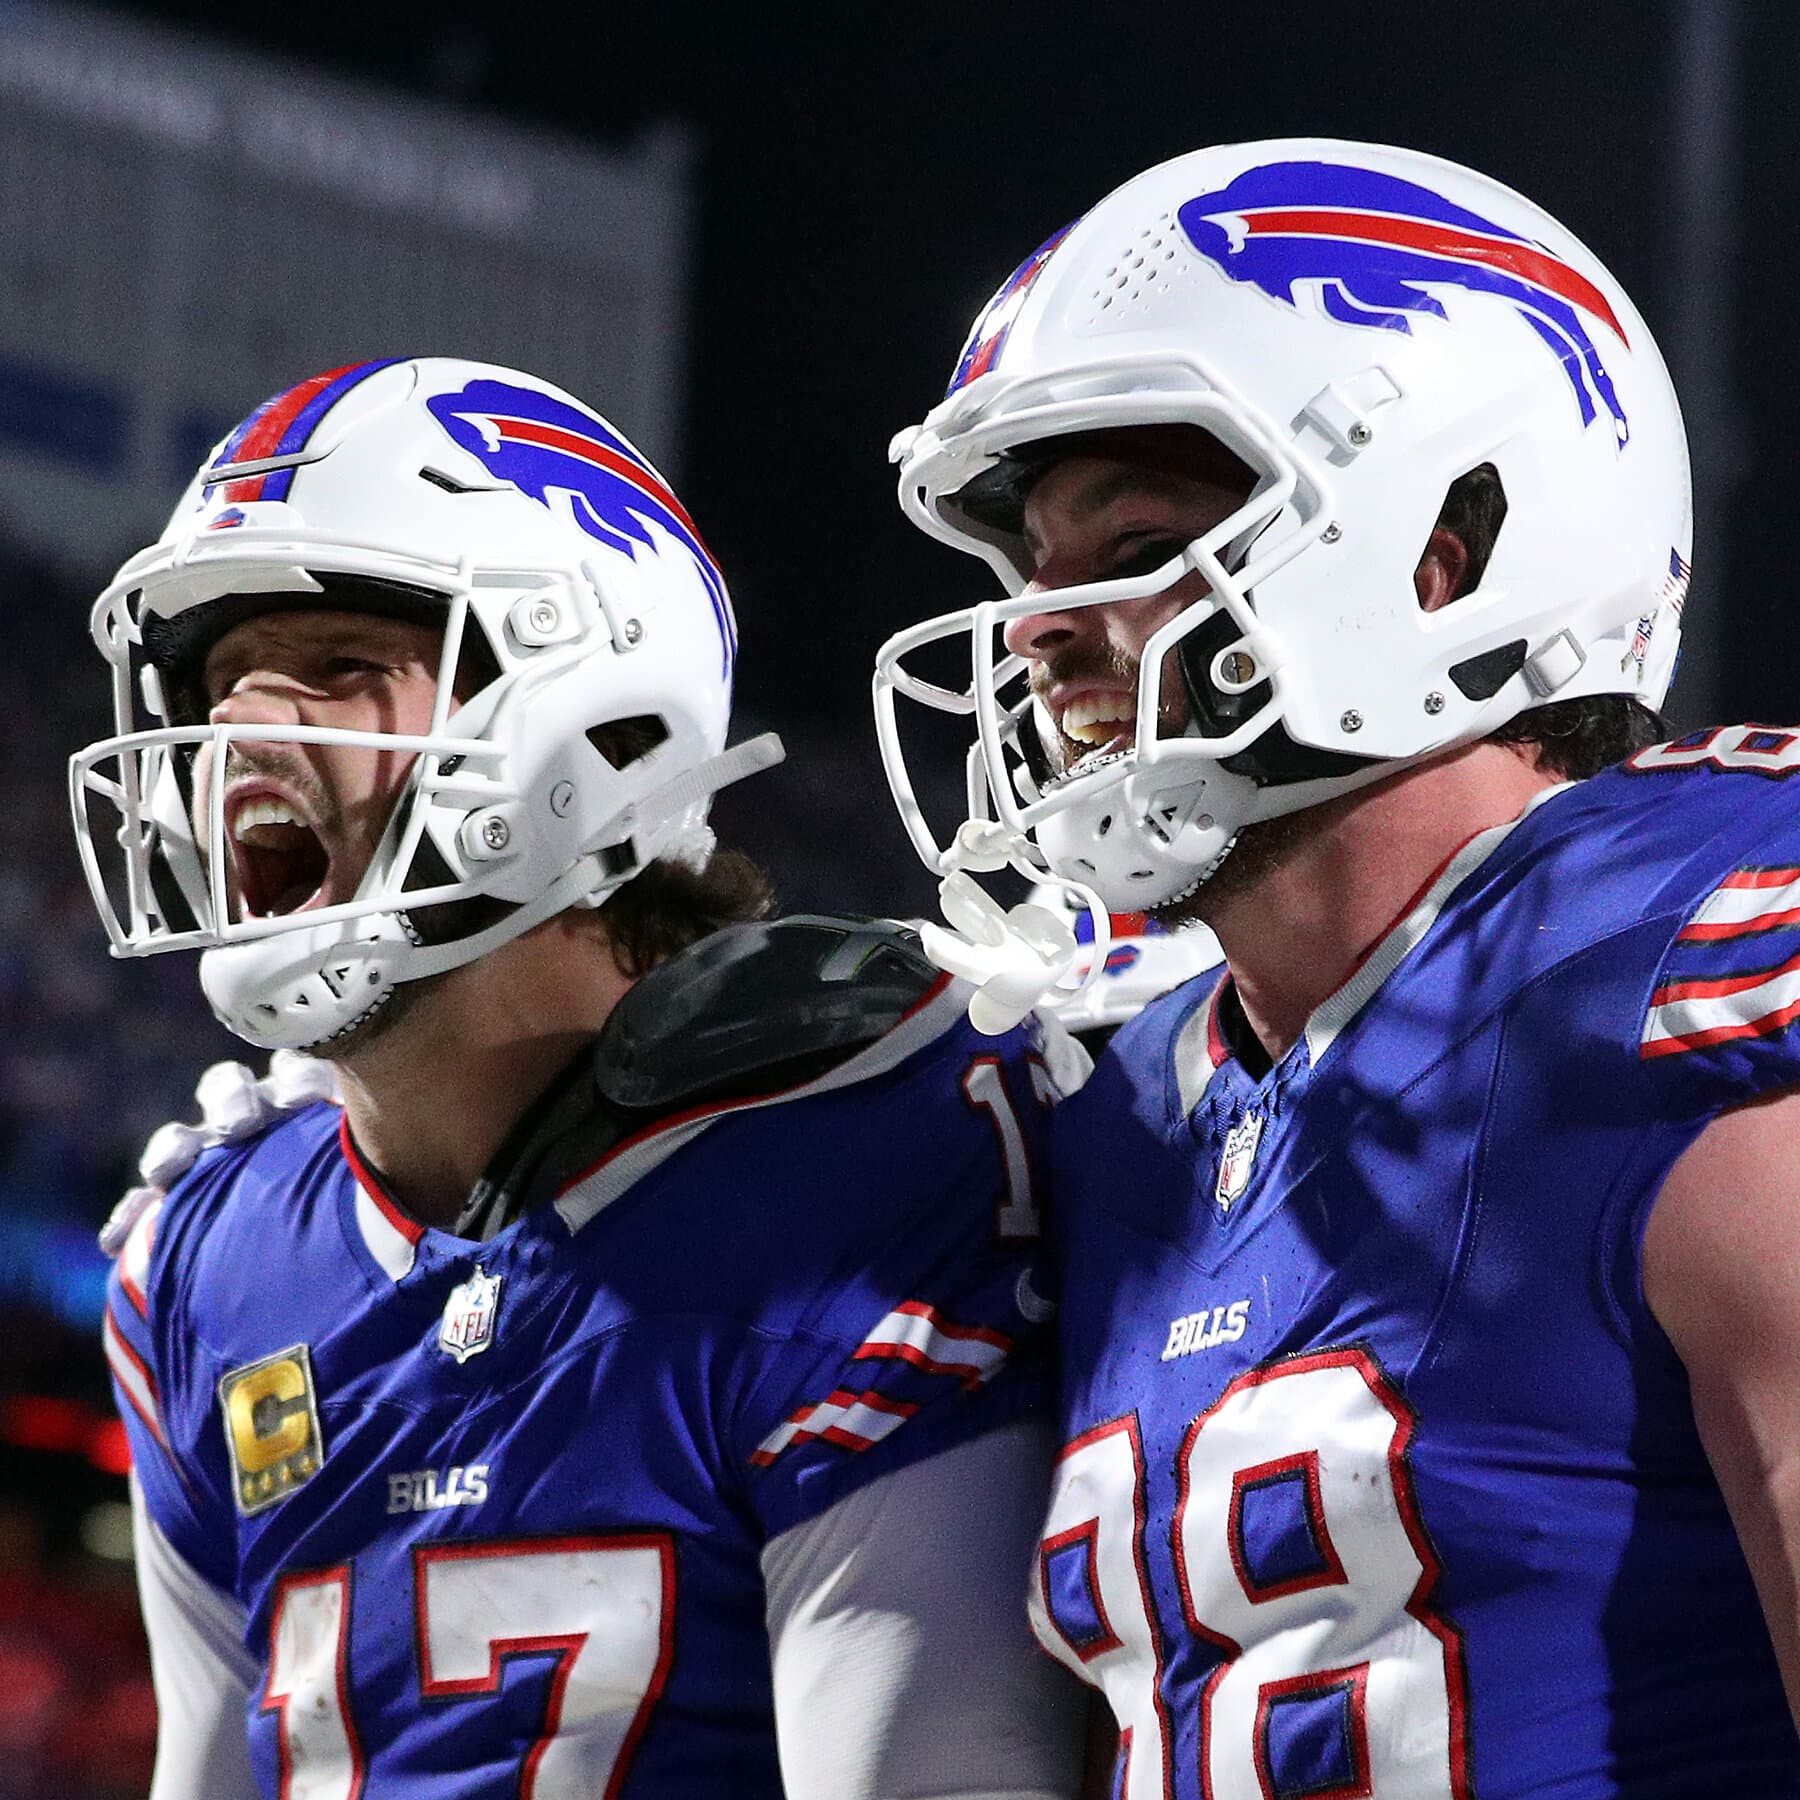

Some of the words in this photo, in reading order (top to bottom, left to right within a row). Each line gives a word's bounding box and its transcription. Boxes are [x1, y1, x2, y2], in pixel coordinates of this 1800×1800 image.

[961, 1053, 1063, 1241] 1
[449, 1311, 488, 1345] NFL
[1160, 1299, 1251, 1362] BILLS
[229, 1359, 310, 1474] C
[387, 1465, 490, 1515] BILLS
[261, 1530, 678, 1800] 17
